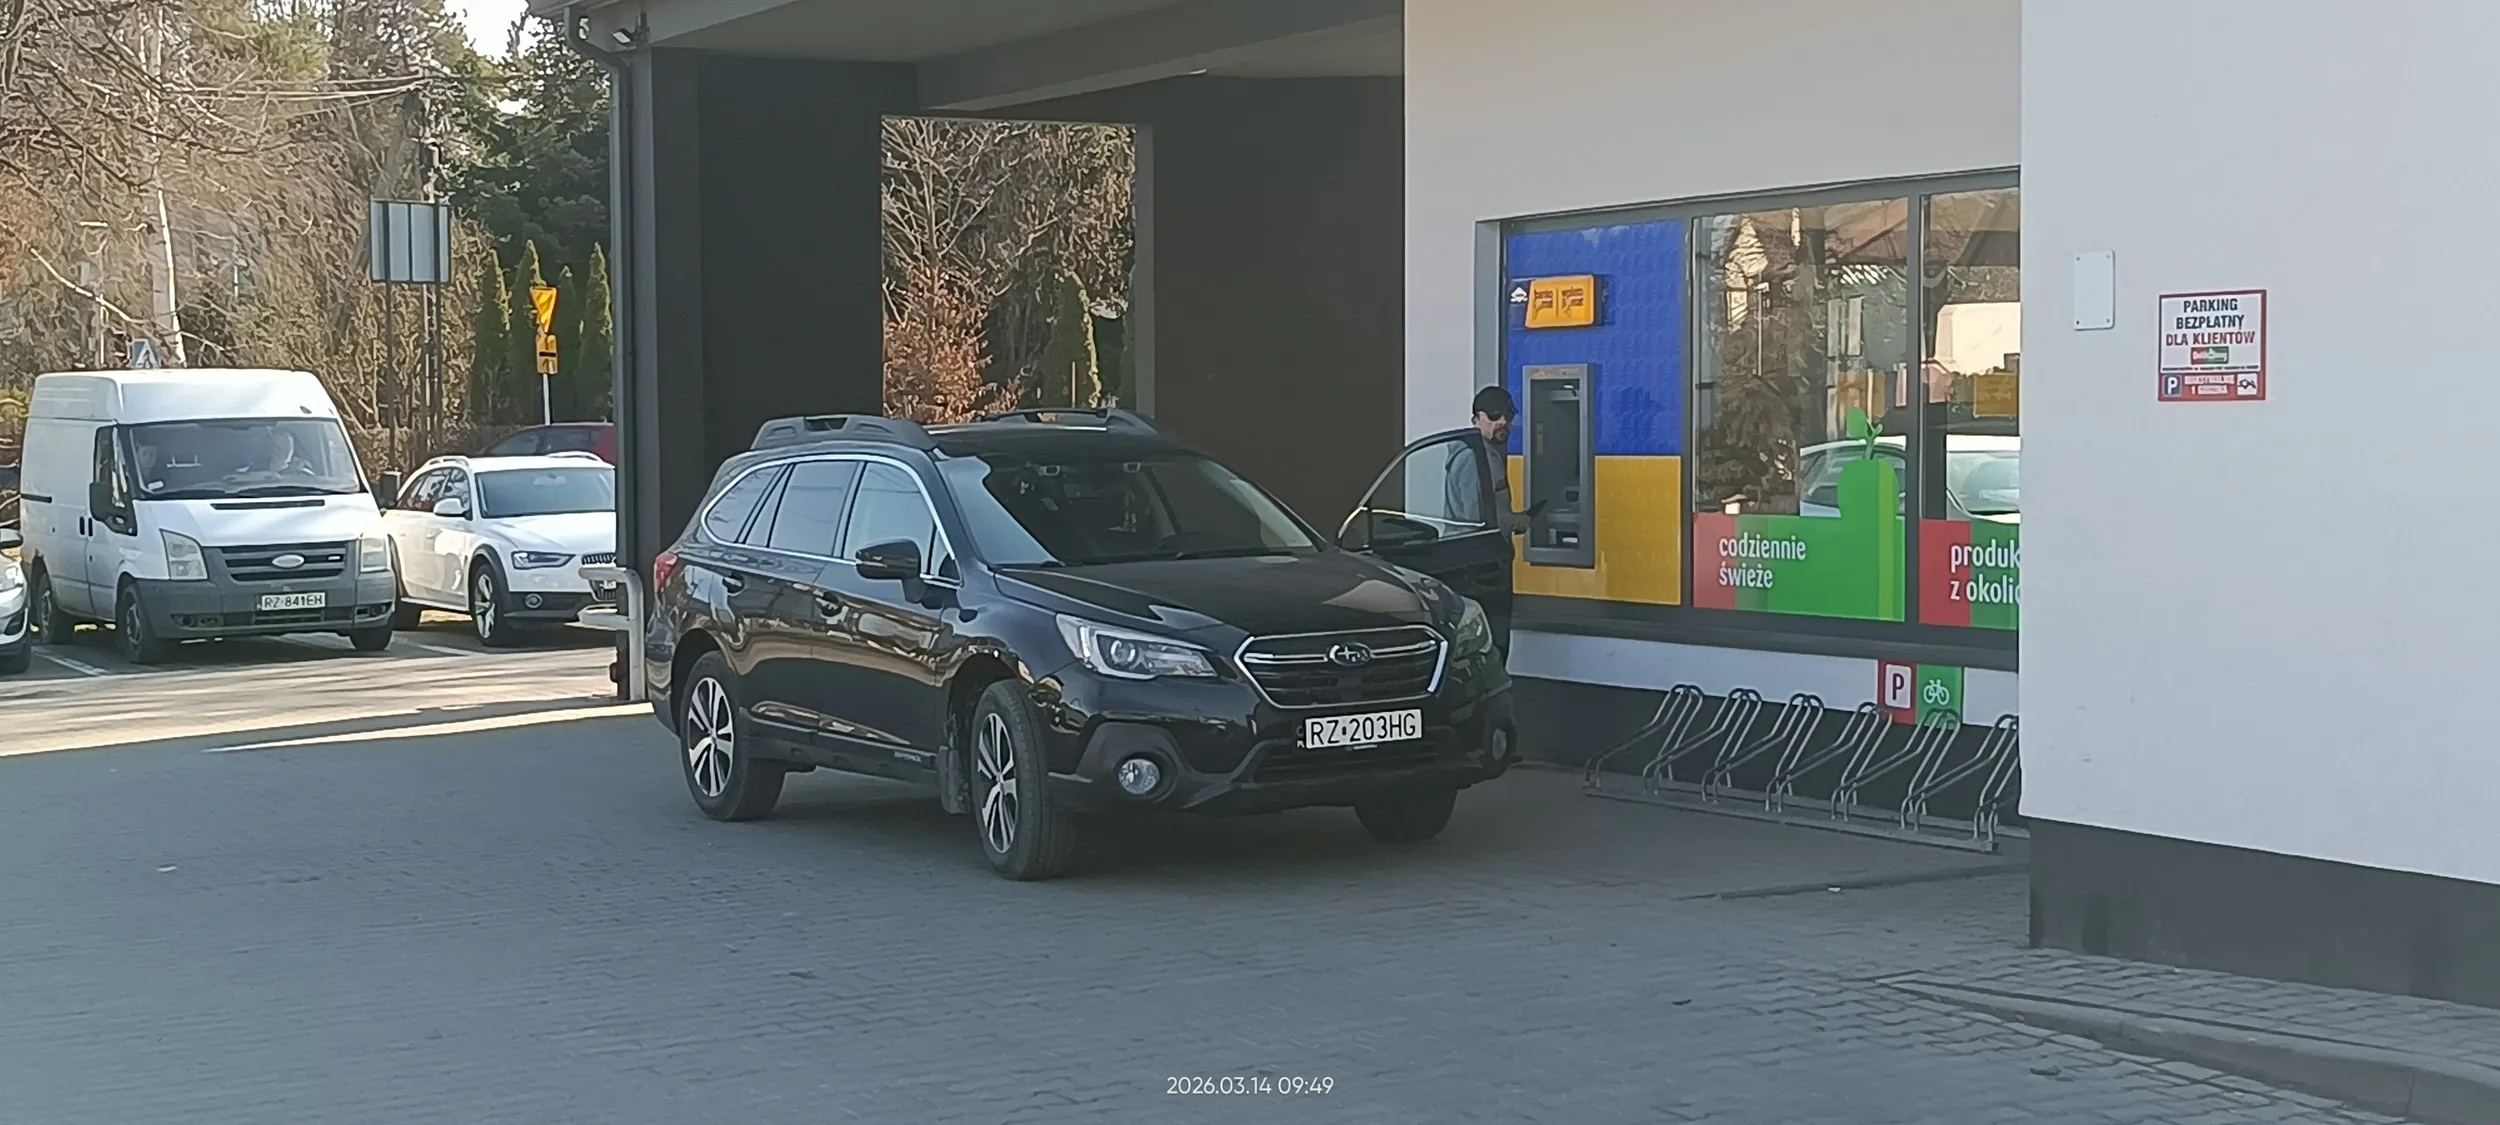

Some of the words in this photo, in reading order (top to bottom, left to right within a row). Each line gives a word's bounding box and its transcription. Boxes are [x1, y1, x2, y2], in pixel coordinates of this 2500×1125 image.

[2183, 298, 2238, 313] PARKING
[2176, 314, 2245, 330] BEZPŁATNY
[2165, 333, 2189, 346] DLA
[1719, 531, 1807, 561] codziennie
[1950, 538, 2020, 573] produk
[1718, 560, 1774, 589] świeże
[1950, 580, 1960, 601] z
[1892, 672, 1905, 701] P
[1310, 720, 1340, 746] RZ
[1349, 713, 1416, 742] 203HG
